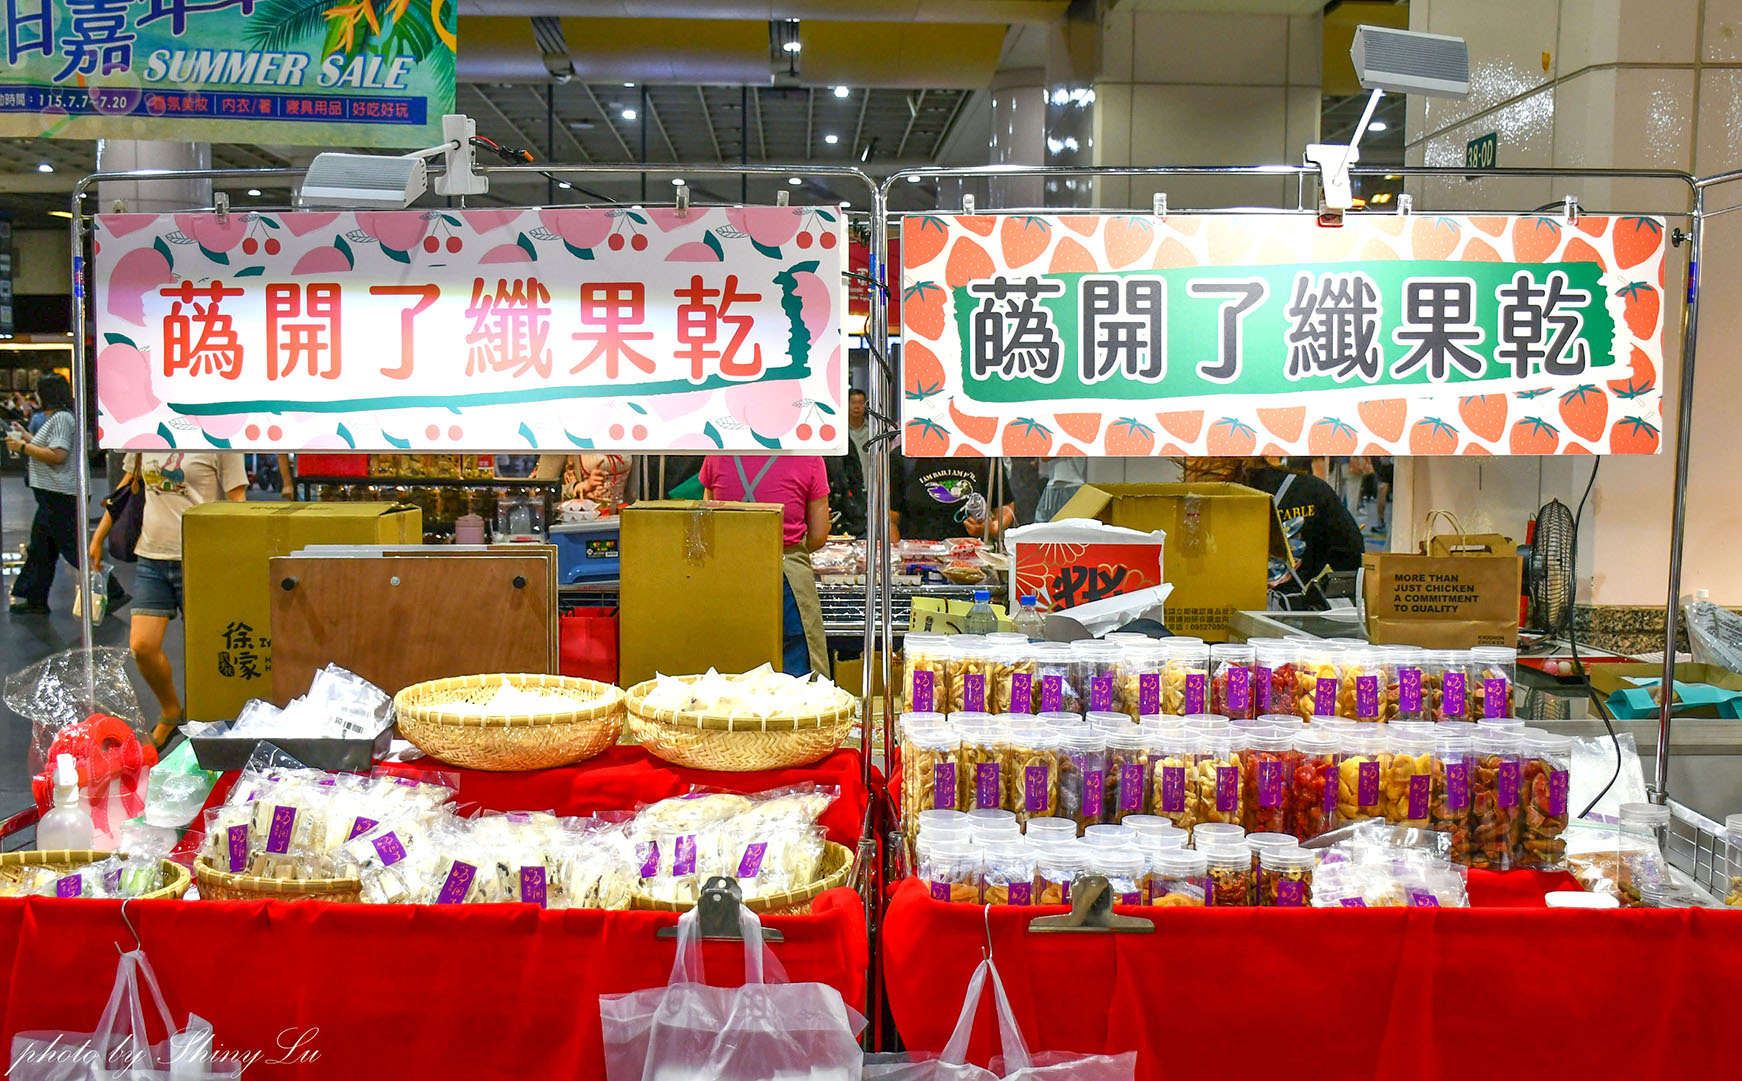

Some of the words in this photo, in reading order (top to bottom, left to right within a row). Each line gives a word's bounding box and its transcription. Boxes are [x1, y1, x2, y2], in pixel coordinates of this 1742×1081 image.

[144, 50, 311, 86] SUMMER
[317, 53, 419, 90] SALE
[352, 101, 409, 118] 好吃好玩
[1395, 574, 1426, 582] MORE
[1429, 574, 1459, 582] THAN
[1394, 584, 1422, 592] JUST
[1425, 584, 1475, 592] CHICKEN
[1405, 595, 1479, 603] COMMITMENT
[1411, 605, 1459, 613] QUALITY
